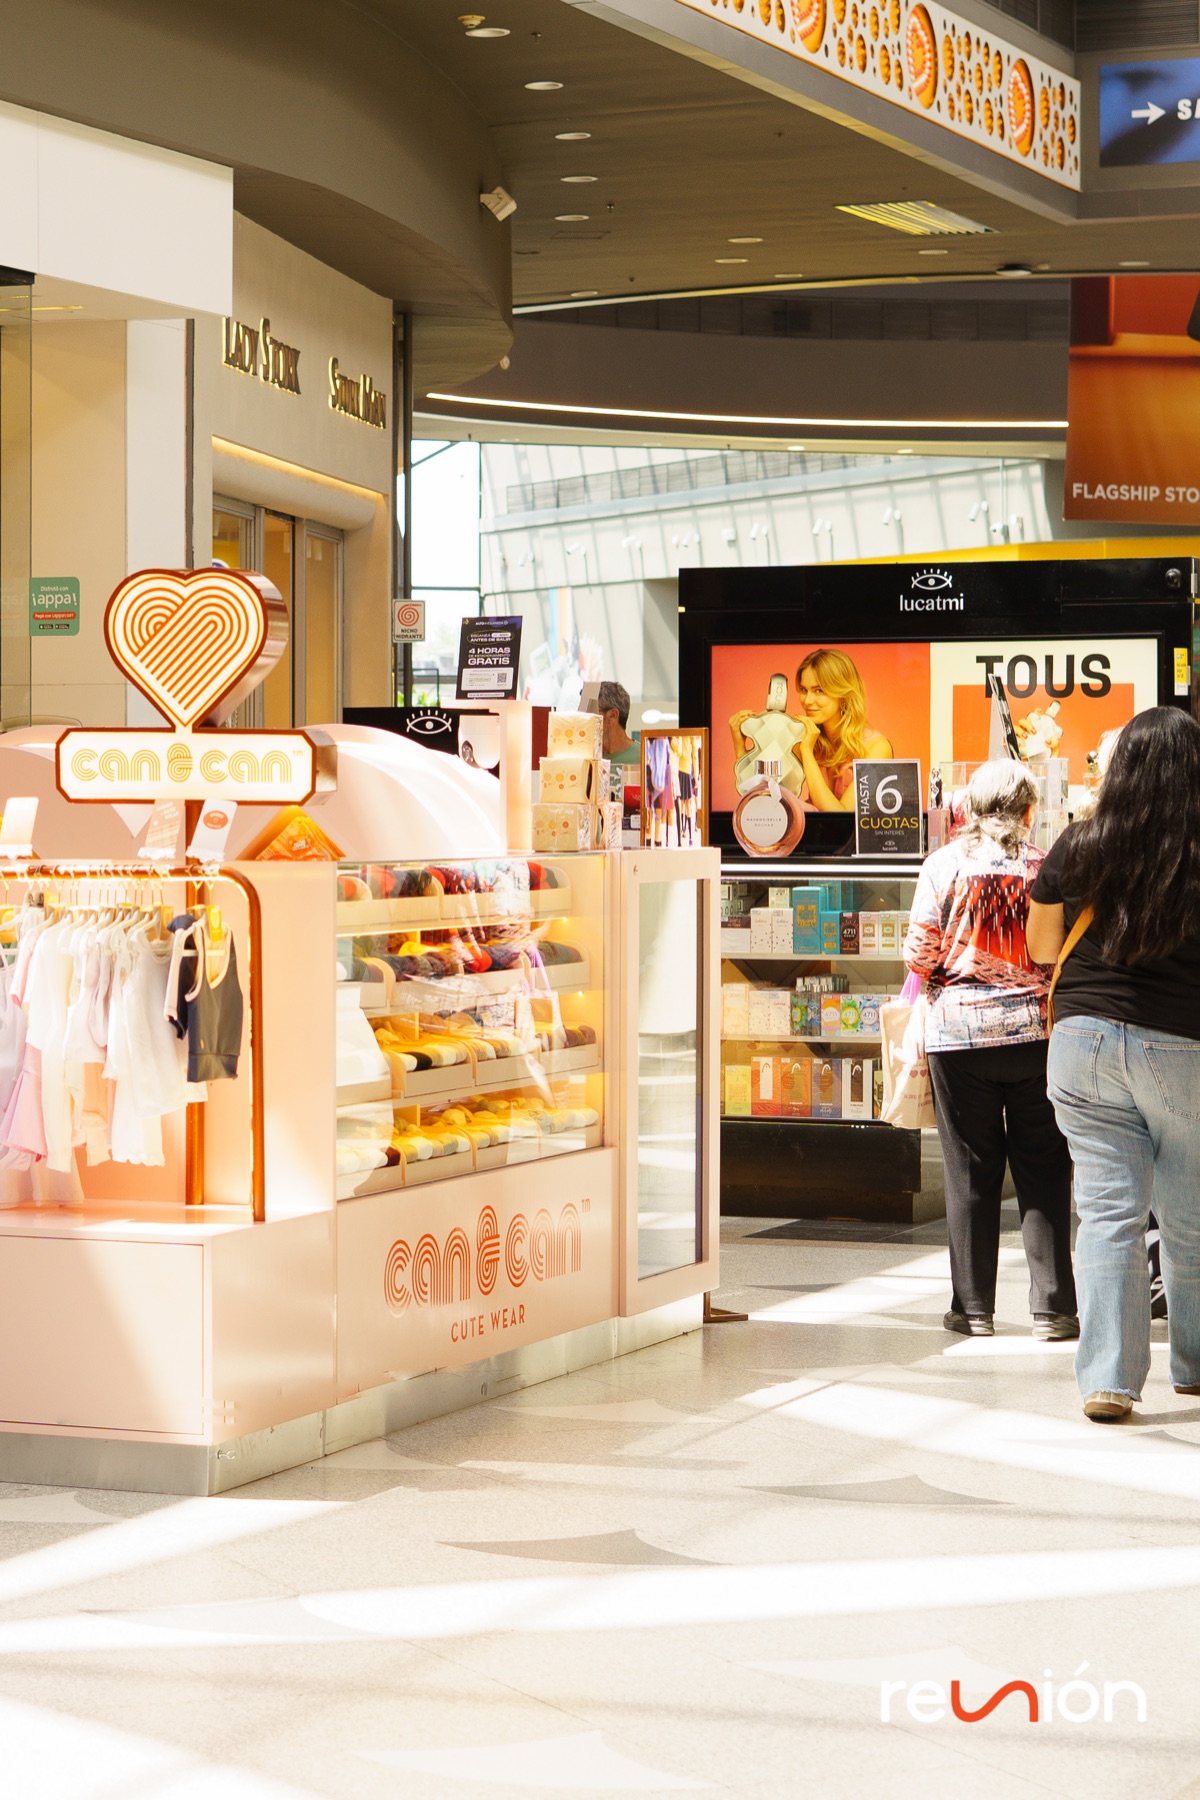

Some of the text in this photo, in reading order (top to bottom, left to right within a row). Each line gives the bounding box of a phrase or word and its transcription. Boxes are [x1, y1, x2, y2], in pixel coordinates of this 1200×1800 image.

[223, 317, 301, 395] LADY STORK
[1072, 483, 1200, 503] FLAGSHIP STO
[900, 593, 964, 611] lucatmi
[467, 657, 510, 665] GRATIS
[976, 653, 1112, 698] TOUS
[860, 775, 870, 814] HASTA
[875, 774, 903, 815] 6
[860, 817, 919, 829] CUOTAS
[843, 928, 856, 936] 4711
[451, 1304, 525, 1343] CUTE WEAR
